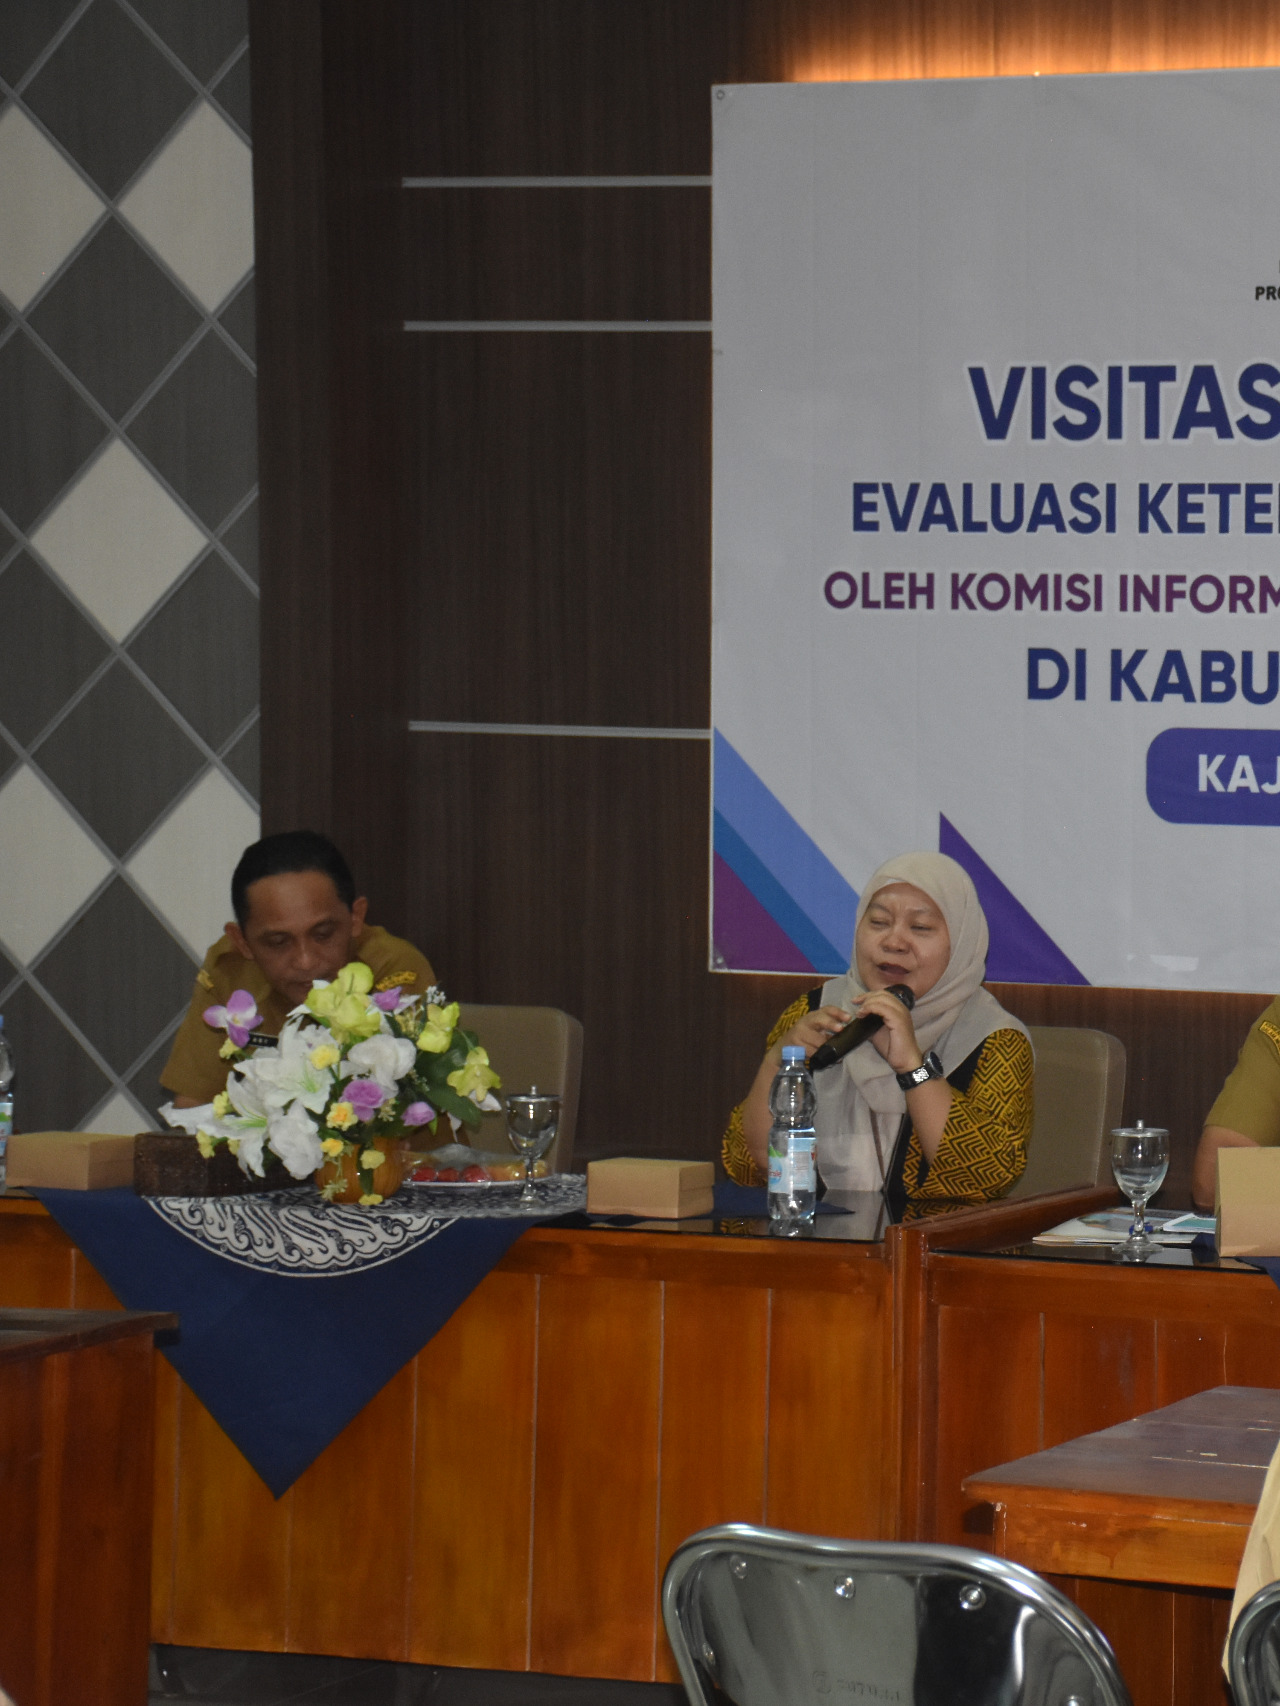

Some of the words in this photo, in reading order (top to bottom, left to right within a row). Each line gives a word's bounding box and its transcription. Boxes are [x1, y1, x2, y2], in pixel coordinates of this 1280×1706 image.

[853, 482, 1117, 535] EVALUASI
[823, 571, 936, 611] OLEH
[951, 572, 1103, 613] KOMISI
[1027, 647, 1088, 702] DI
